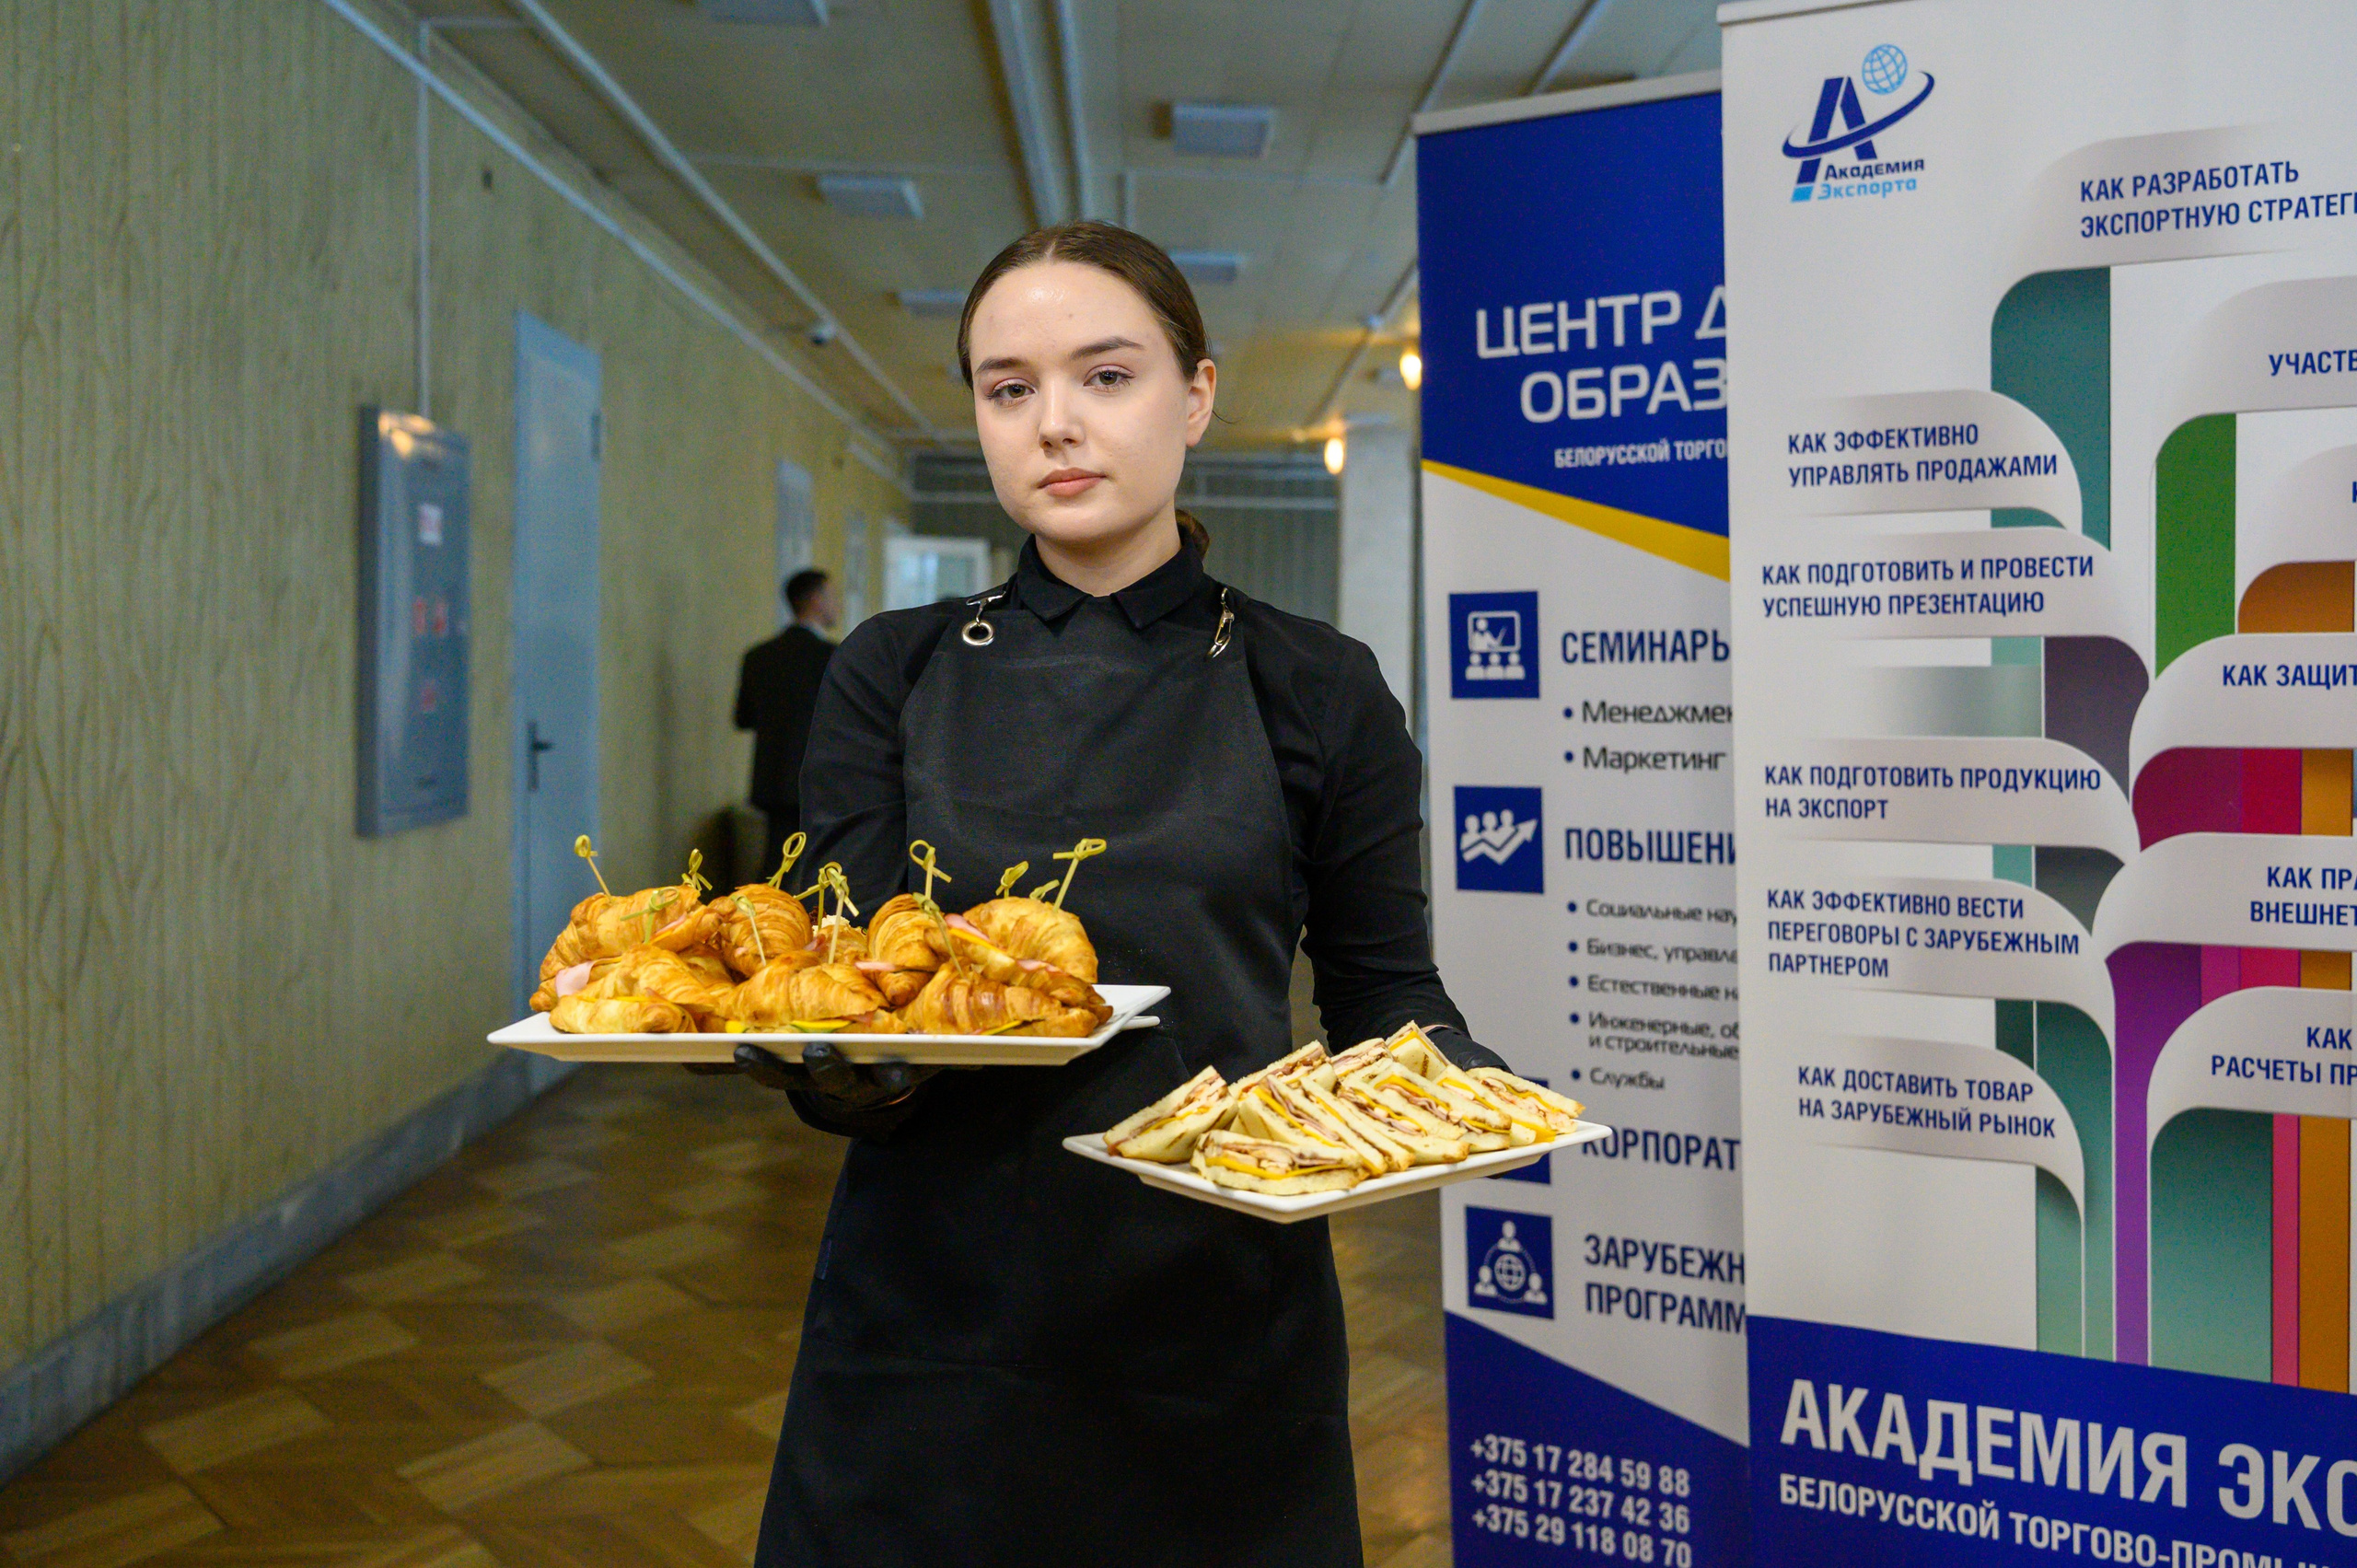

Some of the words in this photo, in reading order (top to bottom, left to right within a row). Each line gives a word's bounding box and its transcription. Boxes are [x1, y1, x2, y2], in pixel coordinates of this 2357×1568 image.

[1824, 158, 1925, 180] Академия
[2080, 177, 2124, 203] КАК
[2132, 160, 2300, 197] РАЗРАБОТАТЬ
[1817, 178, 1918, 201] Экспорта
[2081, 202, 2241, 238] ЭКСПОРТНУЮ
[2248, 192, 2357, 224] СТРАТЕГ
[1475, 290, 1682, 359] ЦЕНТР
[2269, 349, 2357, 377] УЧАСТВ
[1519, 357, 1727, 424] ОБРАЗ
[1554, 437, 1671, 469] БЕЛОРУССКОЙ
[1673, 437, 1728, 460] ТОРГО
[1788, 432, 1827, 454] КАК
[1834, 424, 1979, 452] ЭФФЕКТИВНО
[1788, 462, 1909, 487] УПРАВЛЯТЬ
[1917, 455, 2058, 483] ПРОДАЖАМИ
[1762, 564, 1801, 585] КАК
[1807, 560, 1954, 587] ПОДГОТОВИТЬ
[1961, 560, 1974, 579] И
[1980, 555, 2094, 580] ПРОВЕСТИ
[1762, 595, 1881, 618] УСПЕШНУЮ
[1888, 591, 2045, 616] ПРЕЗЕНТАЦИЮ
[2223, 664, 2268, 687] КАК
[2276, 663, 2357, 691] ЗАЩИТ
[1582, 747, 1726, 773] Маркетинг
[1765, 765, 1803, 785] КАК
[1810, 766, 1954, 790] ПОДГОТОВИТЬ
[1960, 768, 2101, 793] ПРОДУКЦИЮ
[1766, 798, 1792, 818] НА
[1798, 797, 1888, 819] ЭКСПОРТ
[2267, 865, 2312, 889] КАК
[1585, 899, 1702, 921] Социальные
[1767, 889, 1805, 910] КАК
[1812, 889, 1950, 916] ЭФФЕКТИВНО
[1957, 897, 2025, 919] ВЕСТИ
[1586, 937, 1658, 959] Бизнес,
[1768, 922, 1899, 947] ПЕРЕГОВОРЫ
[1907, 927, 1918, 947] С
[1924, 928, 2080, 955] ЗАРУБЕЖНЫМ
[1769, 953, 1889, 978] ПАРТНЕРОМ
[1587, 973, 1720, 1000] Естественные
[1588, 1035, 1602, 1049] и
[1604, 1035, 1739, 1059] строительные
[2306, 1026, 2352, 1051] КАК
[1589, 1066, 1665, 1090] Службы
[1798, 1065, 1836, 1087] КАК
[1843, 1068, 1958, 1098] ДОСТАВИТЬ
[1964, 1078, 2034, 1102] ТОВАР
[2211, 1054, 2321, 1085] РАСЧЕТЫ
[1798, 1098, 1825, 1119] НА
[1831, 1098, 1972, 1132] ЗАРУБЕЖНЫЙ
[1979, 1112, 2056, 1139] РЫНОК
[1584, 1233, 1746, 1285] ЗАРУБЕЖН
[1585, 1282, 1747, 1335] ПРОГРАММ
[1780, 1378, 2189, 1508] АКАДЕМИЯ
[1470, 1434, 1527, 1468] +375
[1532, 1443, 1562, 1473] 17
[1567, 1449, 1613, 1483] 284
[1620, 1458, 1652, 1490] 59
[1659, 1465, 1690, 1497] 88
[1471, 1469, 1528, 1504] +375
[1533, 1479, 1563, 1509] 17
[1568, 1484, 1614, 1519] 237
[1620, 1494, 1651, 1527] 42
[1658, 1501, 1690, 1534] 36
[1779, 1473, 2000, 1540] БЕЛОРУССКОЙ
[1472, 1504, 1529, 1539] +375
[1535, 1513, 1565, 1546] 29
[1571, 1521, 1616, 1556] 118
[1622, 1530, 1655, 1563] 08
[1660, 1539, 1692, 1568] 70
